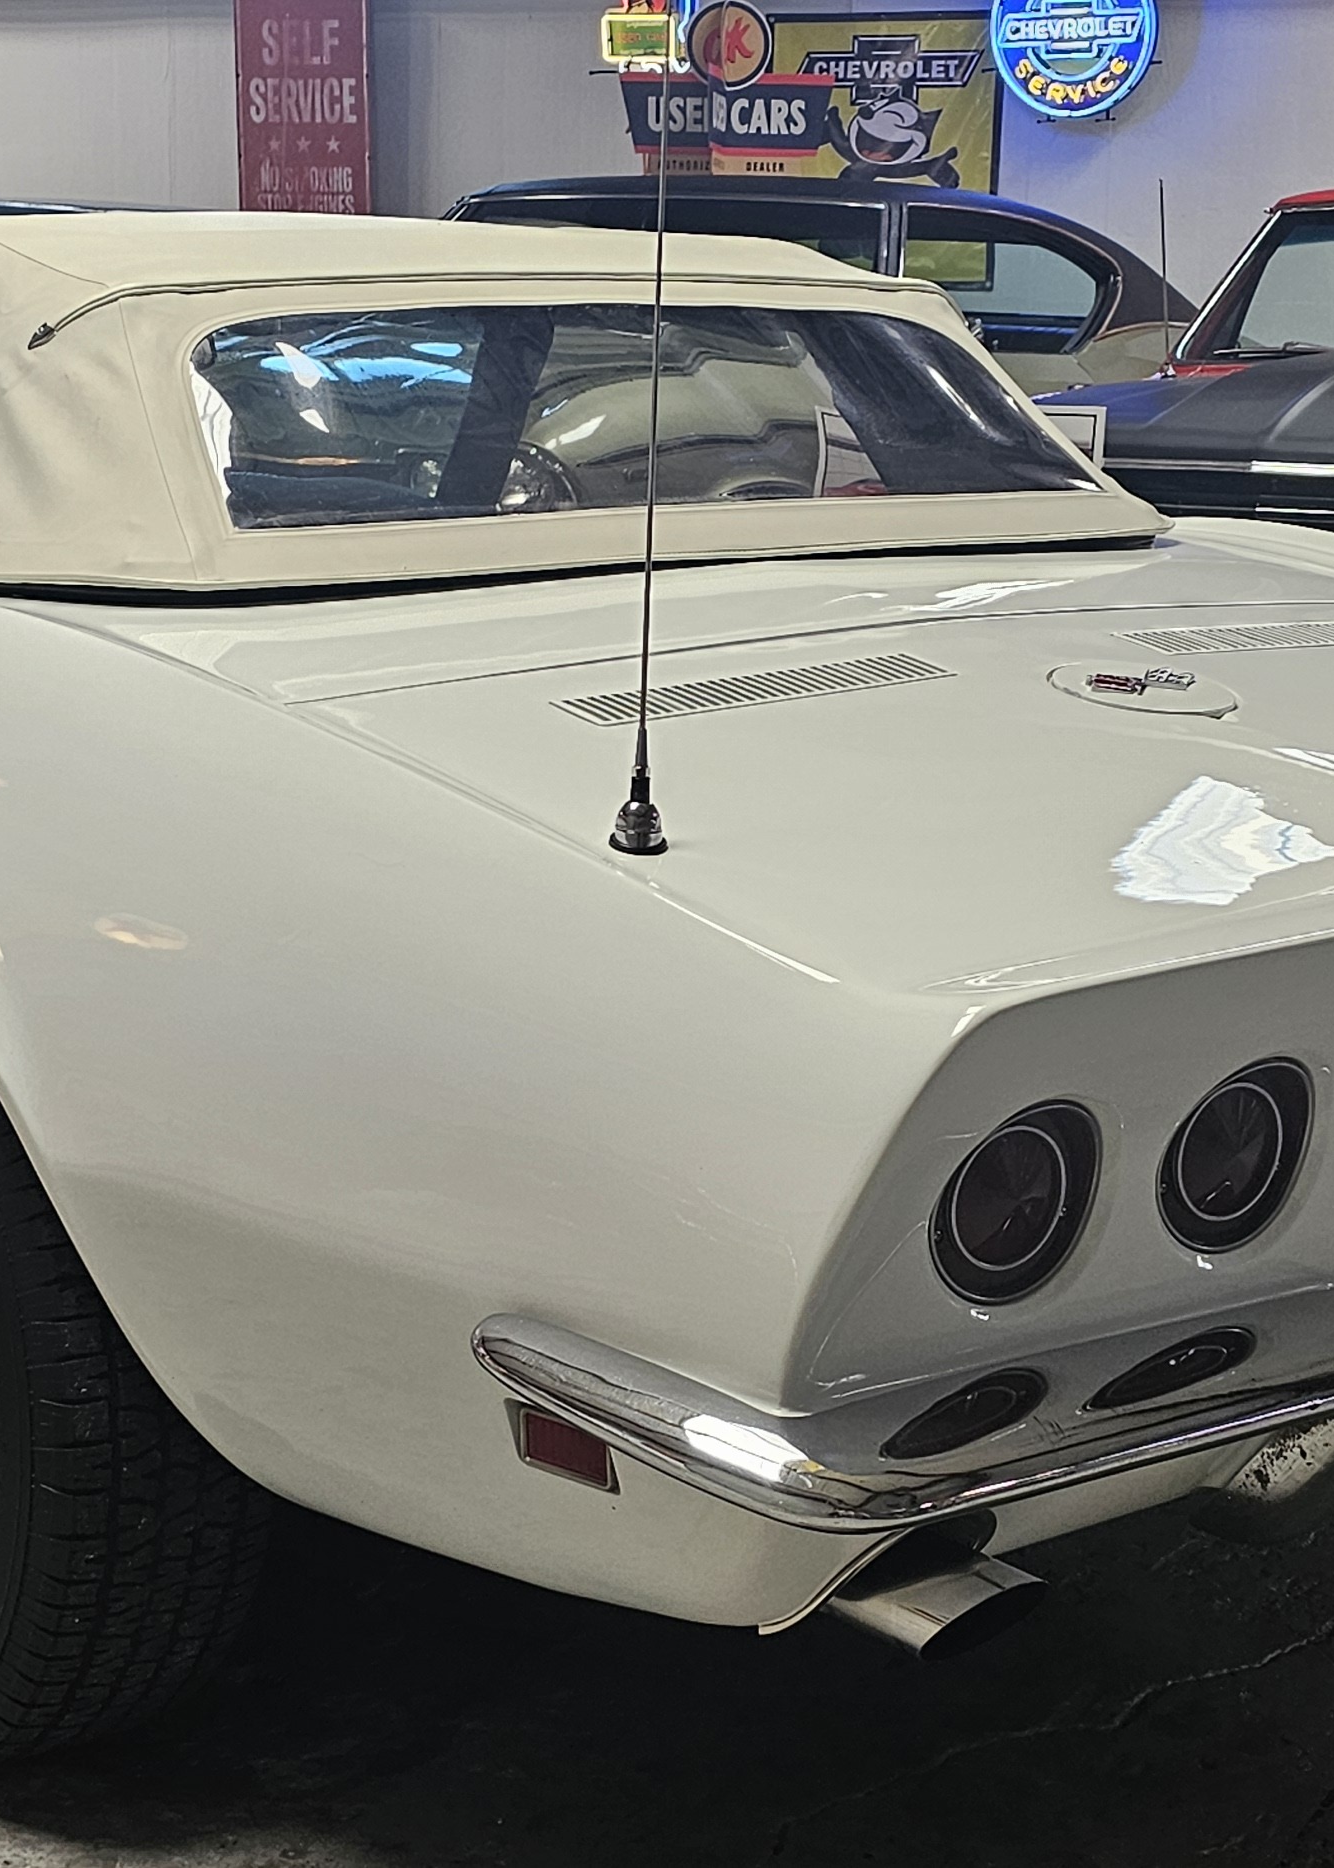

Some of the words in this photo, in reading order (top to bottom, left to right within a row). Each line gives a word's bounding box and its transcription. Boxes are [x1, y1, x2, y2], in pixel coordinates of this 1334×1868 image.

[261, 19, 340, 66] SELF
[1006, 15, 1137, 41] CHEVROLET
[813, 59, 960, 81] CHEVROLET
[1014, 55, 1129, 105] SERVICE
[249, 77, 357, 124] SERVICE
[730, 98, 807, 135] CARS
[260, 161, 280, 192] NO
[657, 158, 725, 172] UTHORIZ
[746, 161, 785, 173] DEALER
